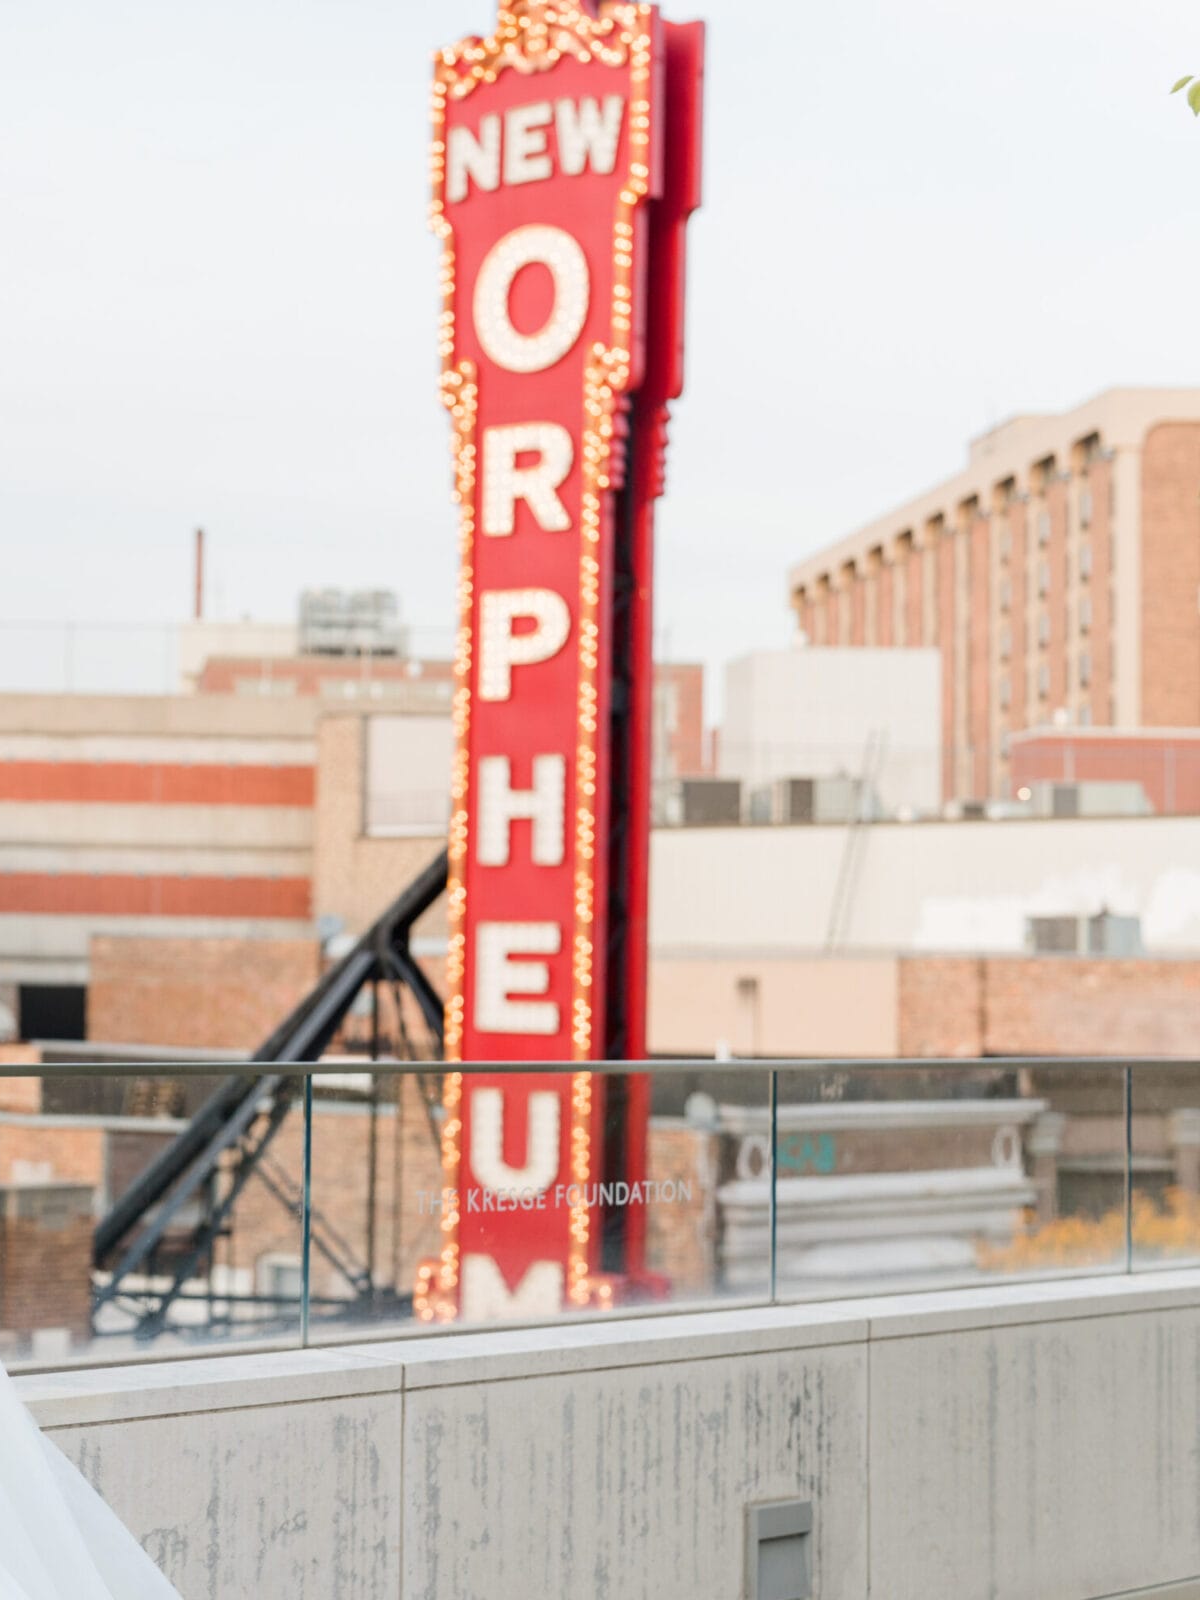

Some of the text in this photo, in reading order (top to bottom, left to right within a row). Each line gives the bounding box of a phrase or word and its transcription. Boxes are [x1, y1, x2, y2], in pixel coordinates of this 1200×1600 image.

[445, 93, 625, 204] NEW
[459, 222, 591, 1321] ORPHEUM
[415, 1178, 694, 1215] THE KRESGE FOUNDATION
